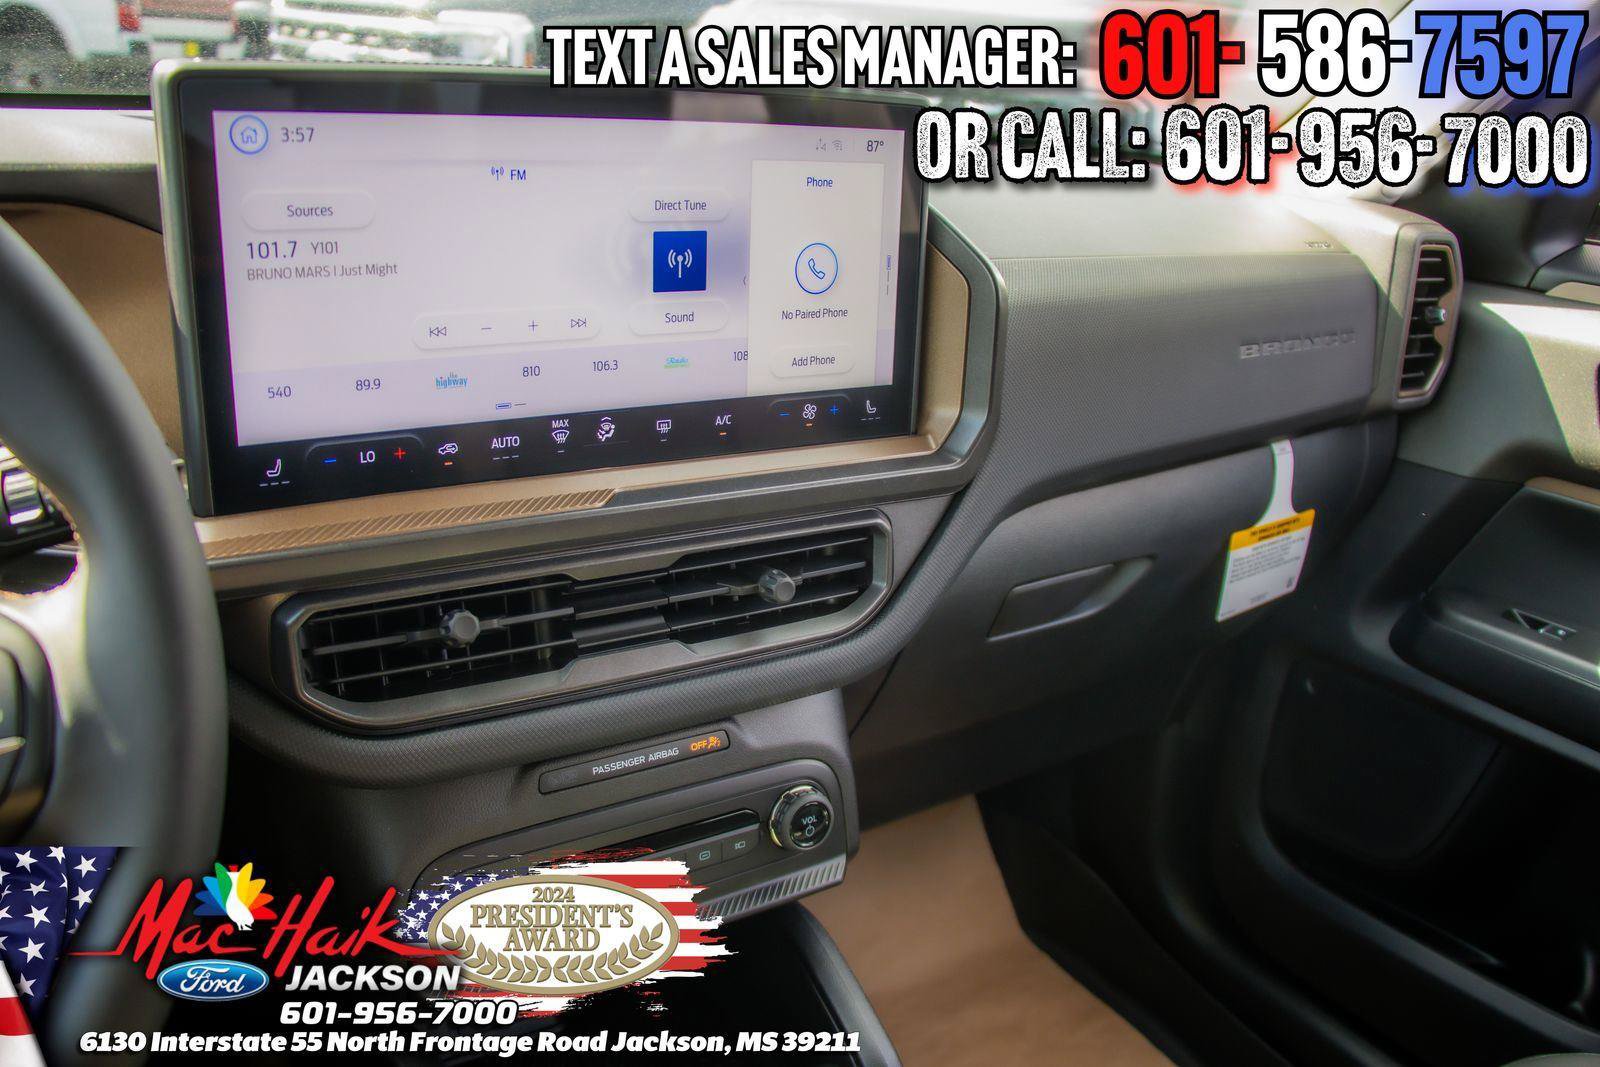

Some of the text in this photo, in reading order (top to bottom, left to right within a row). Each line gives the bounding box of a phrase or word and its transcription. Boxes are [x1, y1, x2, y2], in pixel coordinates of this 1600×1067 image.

[281, 127, 315, 143] 3:57
[510, 169, 527, 181] FM
[806, 176, 833, 188] Phone
[287, 204, 334, 217] Sources
[654, 199, 707, 212] Direct Tune
[246, 240, 340, 259] 101.7 Y101
[247, 267, 292, 281] BRUNO
[295, 266, 331, 279] MARS
[340, 264, 362, 276] Just
[366, 263, 398, 277] Might
[664, 311, 695, 324] Sound
[781, 307, 849, 320] No Paired Phone
[592, 360, 619, 372] 106.3
[791, 354, 836, 367] Add Phone
[522, 365, 541, 377] 810
[355, 378, 381, 391] 89.9
[435, 376, 468, 389] highway
[267, 386, 292, 399] 540
[552, 419, 569, 428] MAX
[715, 415, 732, 426] A/C
[491, 436, 520, 449] AUTO
[359, 450, 375, 464] LO
[592, 741, 708, 776] PASSENGER AIRBAG OFF
[802, 815, 817, 825] VOL
